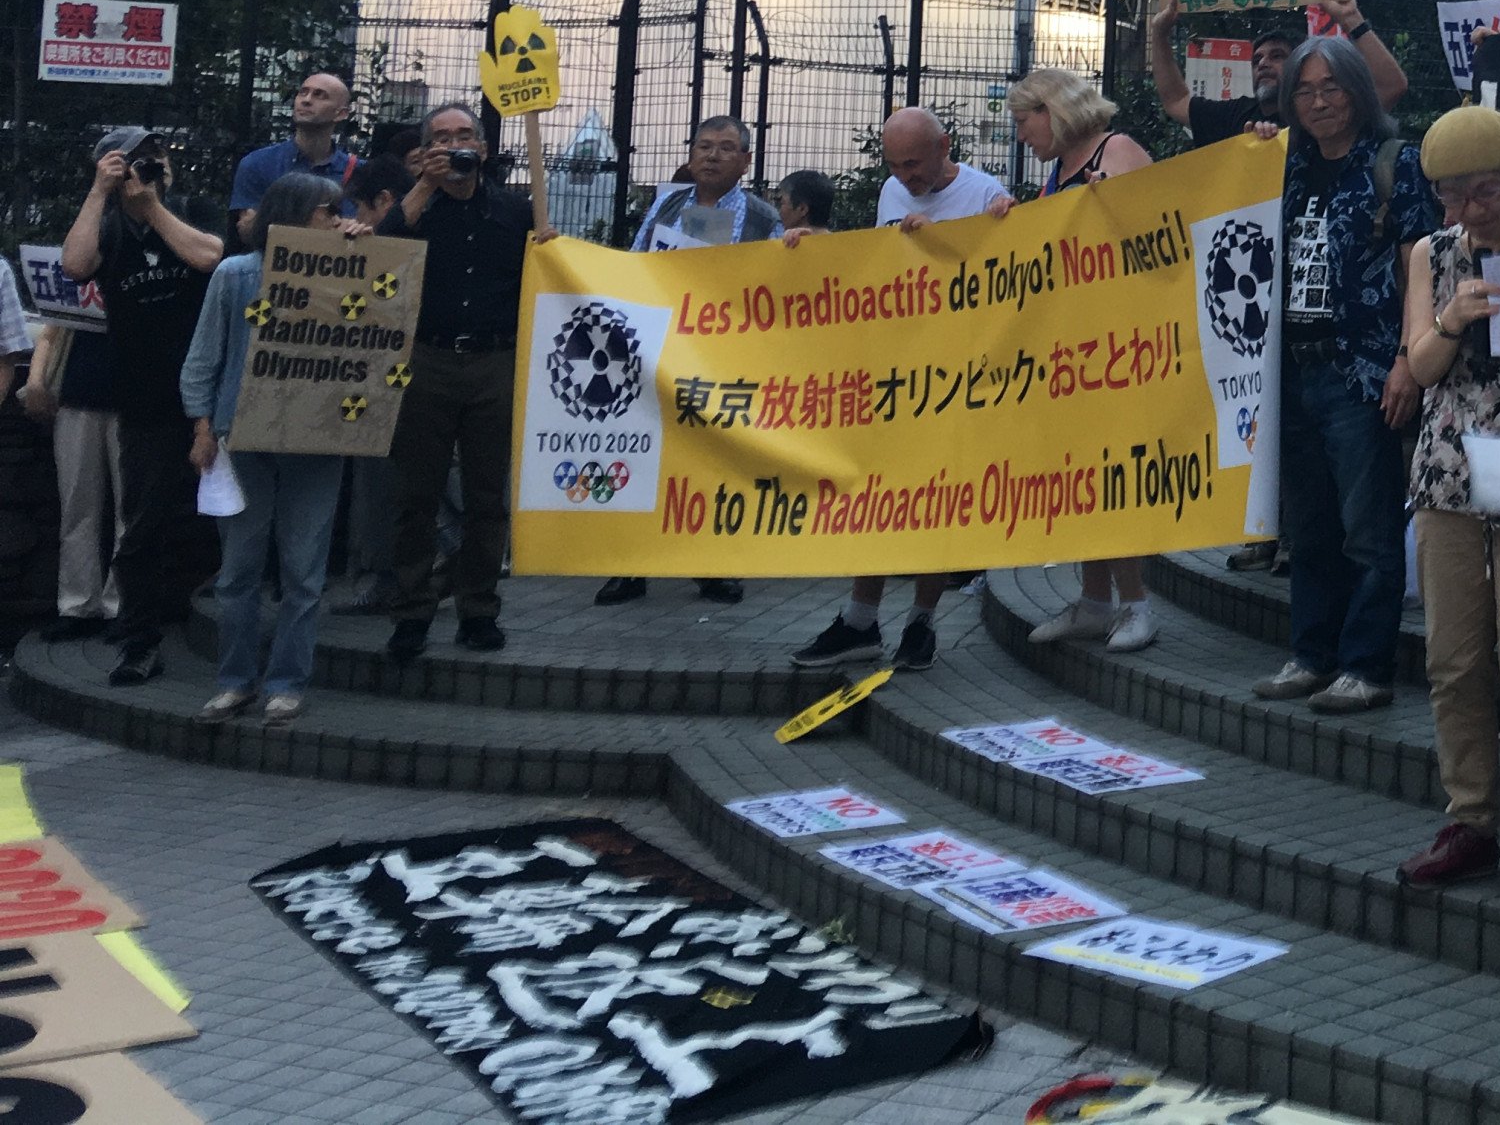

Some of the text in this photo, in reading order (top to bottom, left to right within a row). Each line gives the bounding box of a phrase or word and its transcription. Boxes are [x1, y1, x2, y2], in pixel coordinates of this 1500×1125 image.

[54, 1, 165, 43] 禁煙
[500, 86, 543, 107] STOP
[272, 246, 367, 280] Boycott
[269, 280, 310, 311] the
[676, 290, 730, 337] Les
[737, 283, 775, 335] JO
[782, 265, 942, 331] radioactifs
[948, 264, 980, 314] de
[985, 244, 1054, 304] Tokyo?
[1060, 236, 1115, 287] Non
[258, 315, 405, 352] Radioactive
[251, 347, 369, 384] Olympics
[1217, 371, 1262, 402] TOKYO
[536, 431, 652, 455] TOKYO 2020
[661, 475, 706, 537] No
[712, 483, 744, 536] to
[751, 475, 808, 537] The
[810, 461, 974, 537] Radioactive
[979, 456, 1097, 540] Olympics
[1101, 446, 1126, 510] in
[1026, 726, 1087, 746] NO
[814, 795, 880, 818] NO
